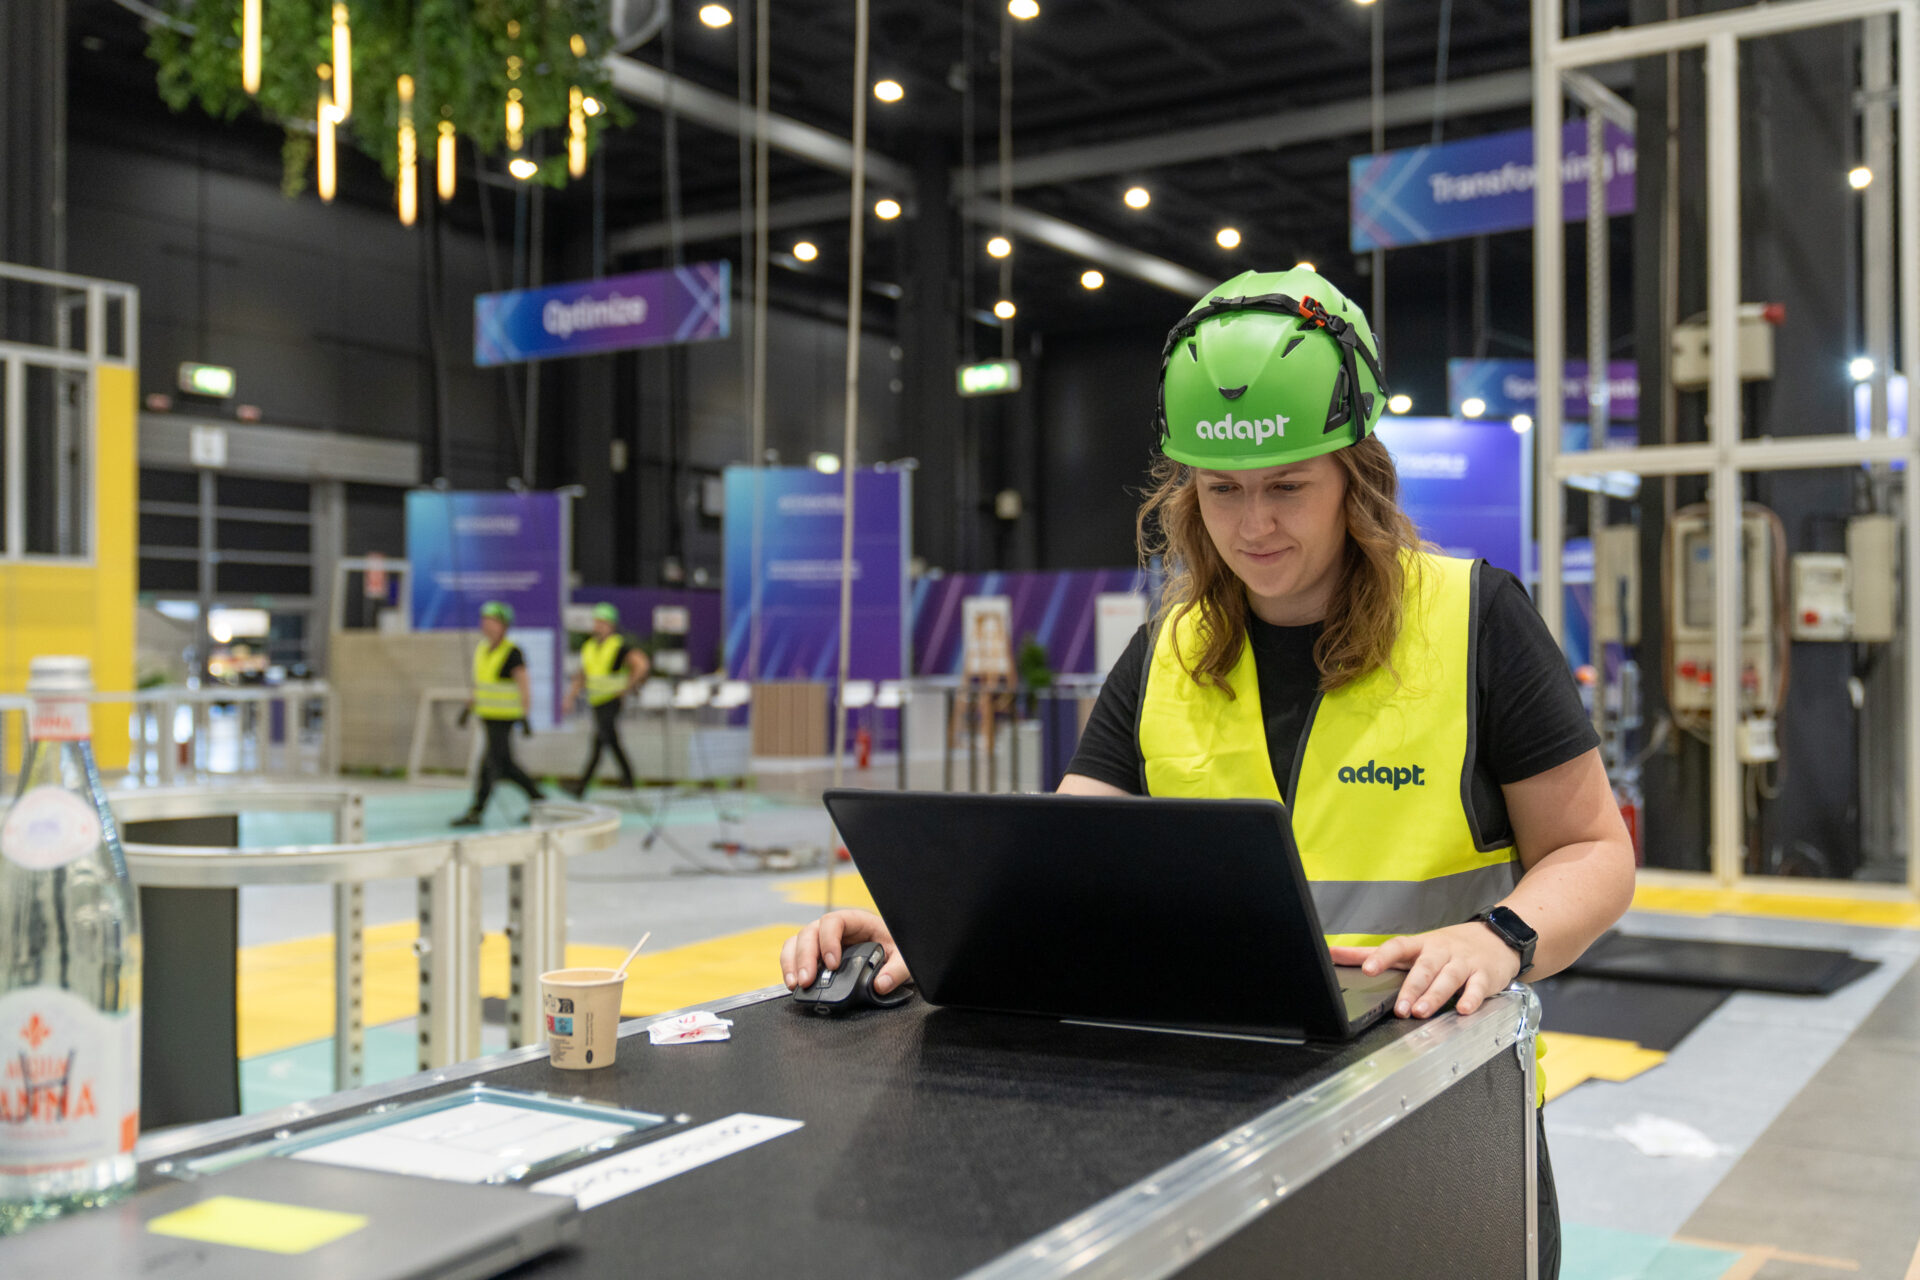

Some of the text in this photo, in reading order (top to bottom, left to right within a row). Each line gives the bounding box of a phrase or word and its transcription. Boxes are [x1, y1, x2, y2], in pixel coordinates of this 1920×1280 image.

[1430, 153, 1613, 202] Transforing
[543, 292, 647, 339] Optimize
[1196, 413, 1290, 446] adapt
